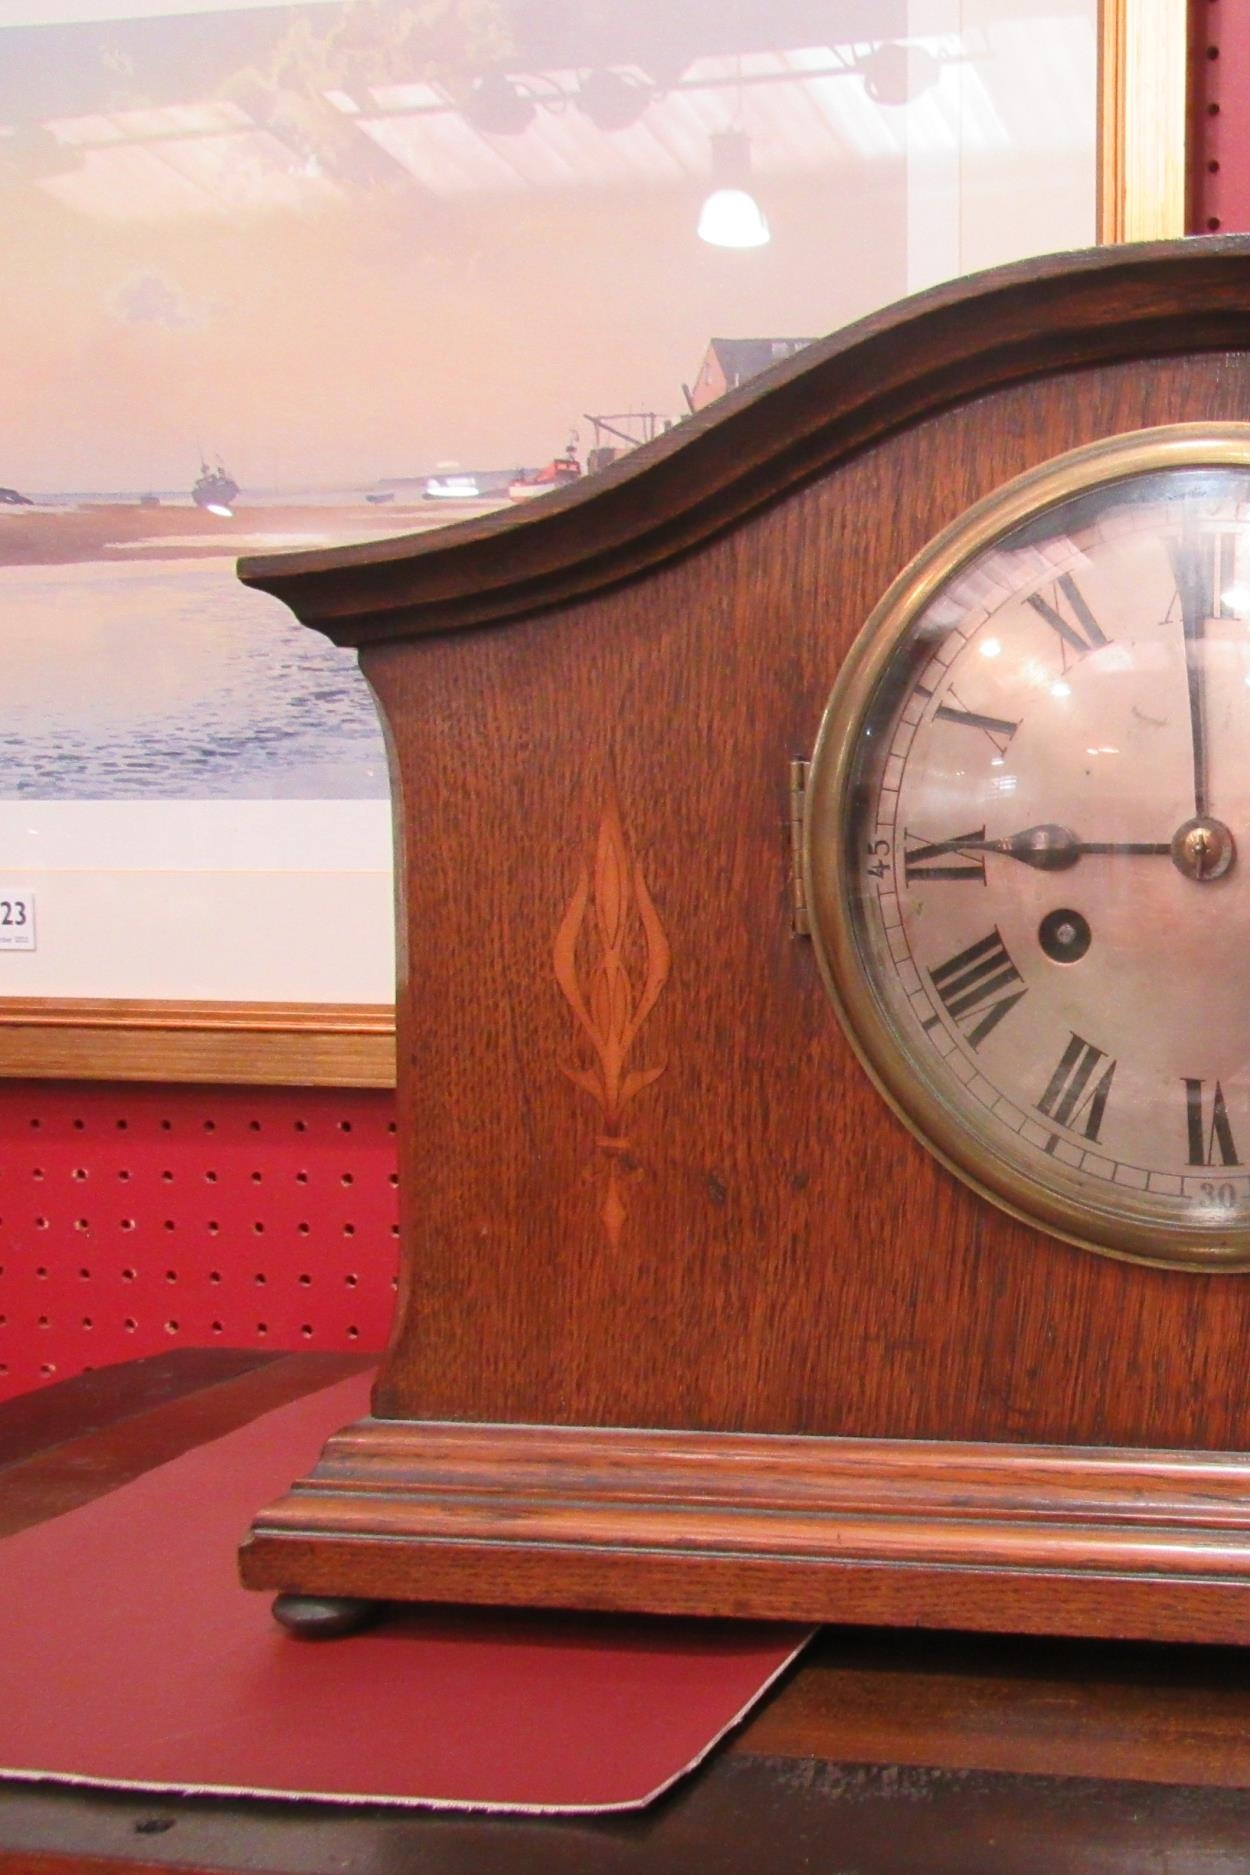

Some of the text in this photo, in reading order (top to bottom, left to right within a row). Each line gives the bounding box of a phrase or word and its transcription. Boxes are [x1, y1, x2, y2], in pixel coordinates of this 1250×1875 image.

[1020, 568, 1114, 676] XI
[930, 682, 1024, 757] X
[866, 839, 891, 880] 45
[904, 823, 988, 889] IX
[927, 923, 1029, 1055] VIII
[1032, 1030, 1118, 1145] VII
[1179, 1076, 1245, 1167] VI
[1198, 1181, 1237, 1208] 30
